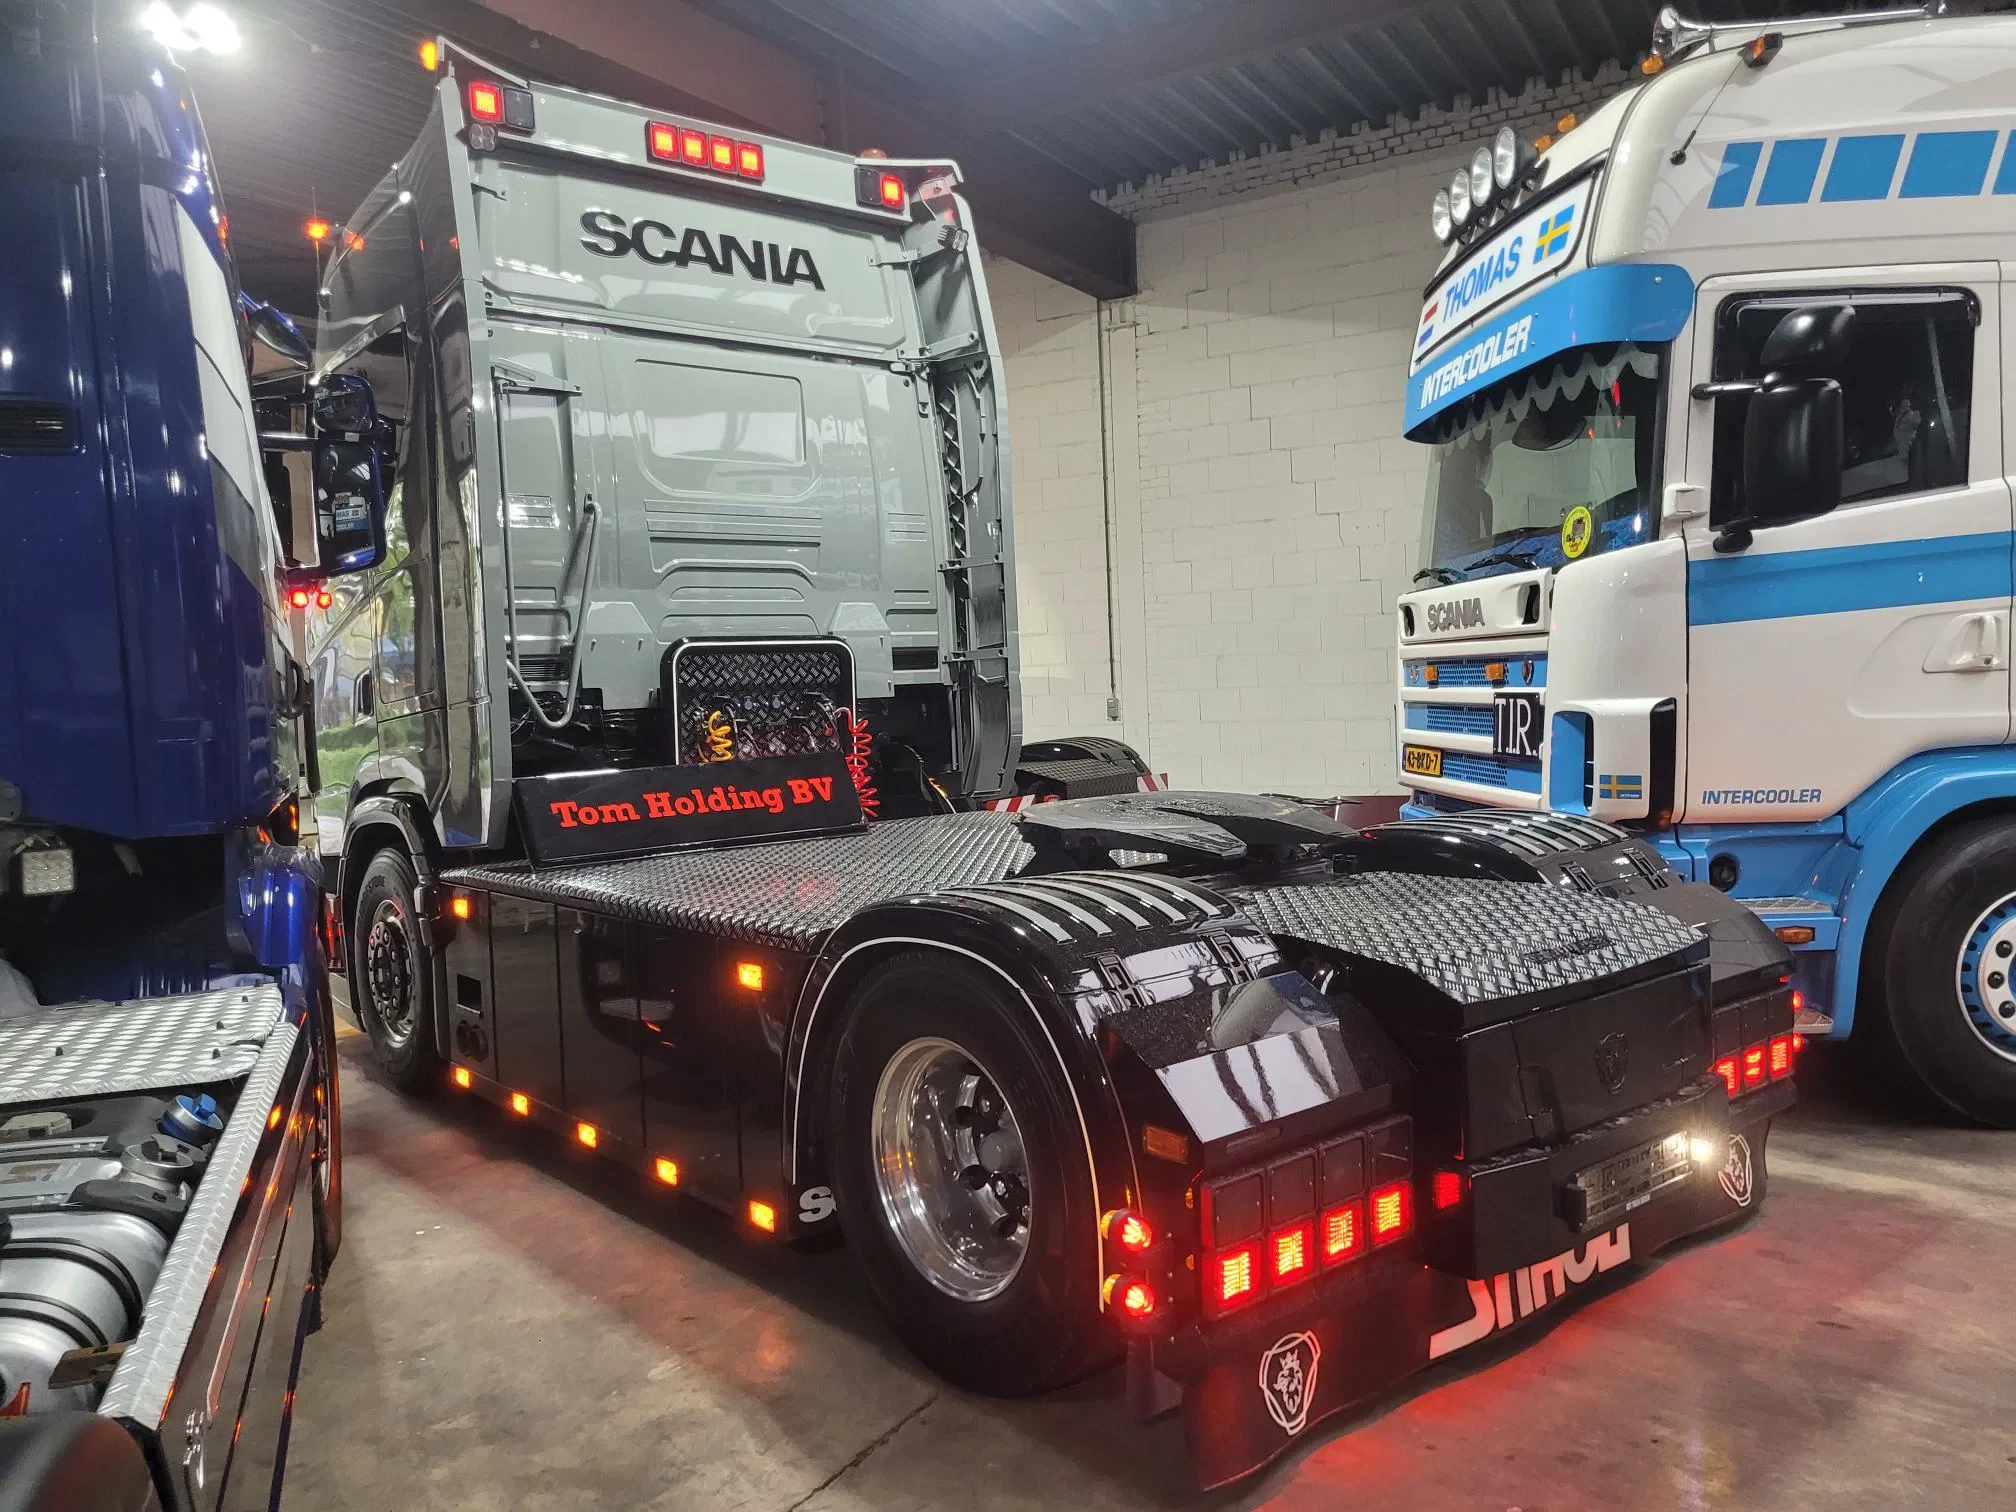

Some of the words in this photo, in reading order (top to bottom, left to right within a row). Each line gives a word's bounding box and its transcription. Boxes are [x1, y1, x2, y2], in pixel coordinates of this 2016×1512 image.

[580, 208, 826, 292] SCANIA
[1443, 235, 1524, 322] THOMAS
[1420, 314, 1533, 409] INTERCOOLER
[1427, 597, 1486, 633] SCANIA
[550, 800, 641, 828] Tom
[643, 785, 784, 814] Holding
[787, 776, 833, 804] BV
[1702, 788, 1822, 804] INTERCOOLER
